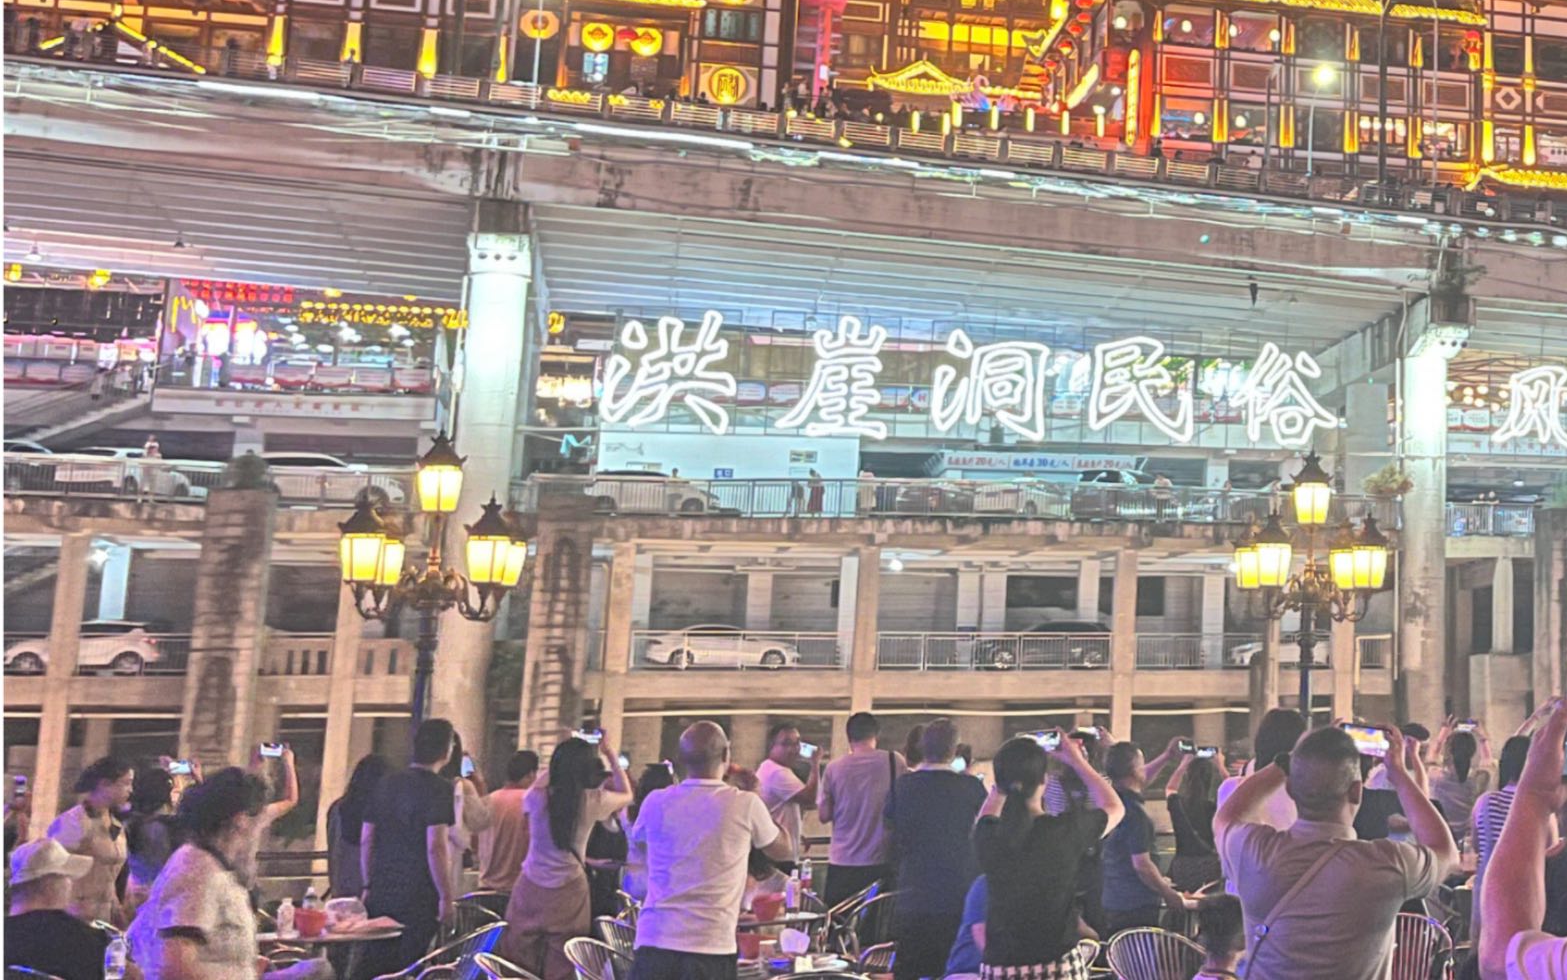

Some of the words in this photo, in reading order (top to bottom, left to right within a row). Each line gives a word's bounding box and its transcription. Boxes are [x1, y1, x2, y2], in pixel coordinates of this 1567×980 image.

[598, 310, 1339, 447] 洪崖洞民俗
